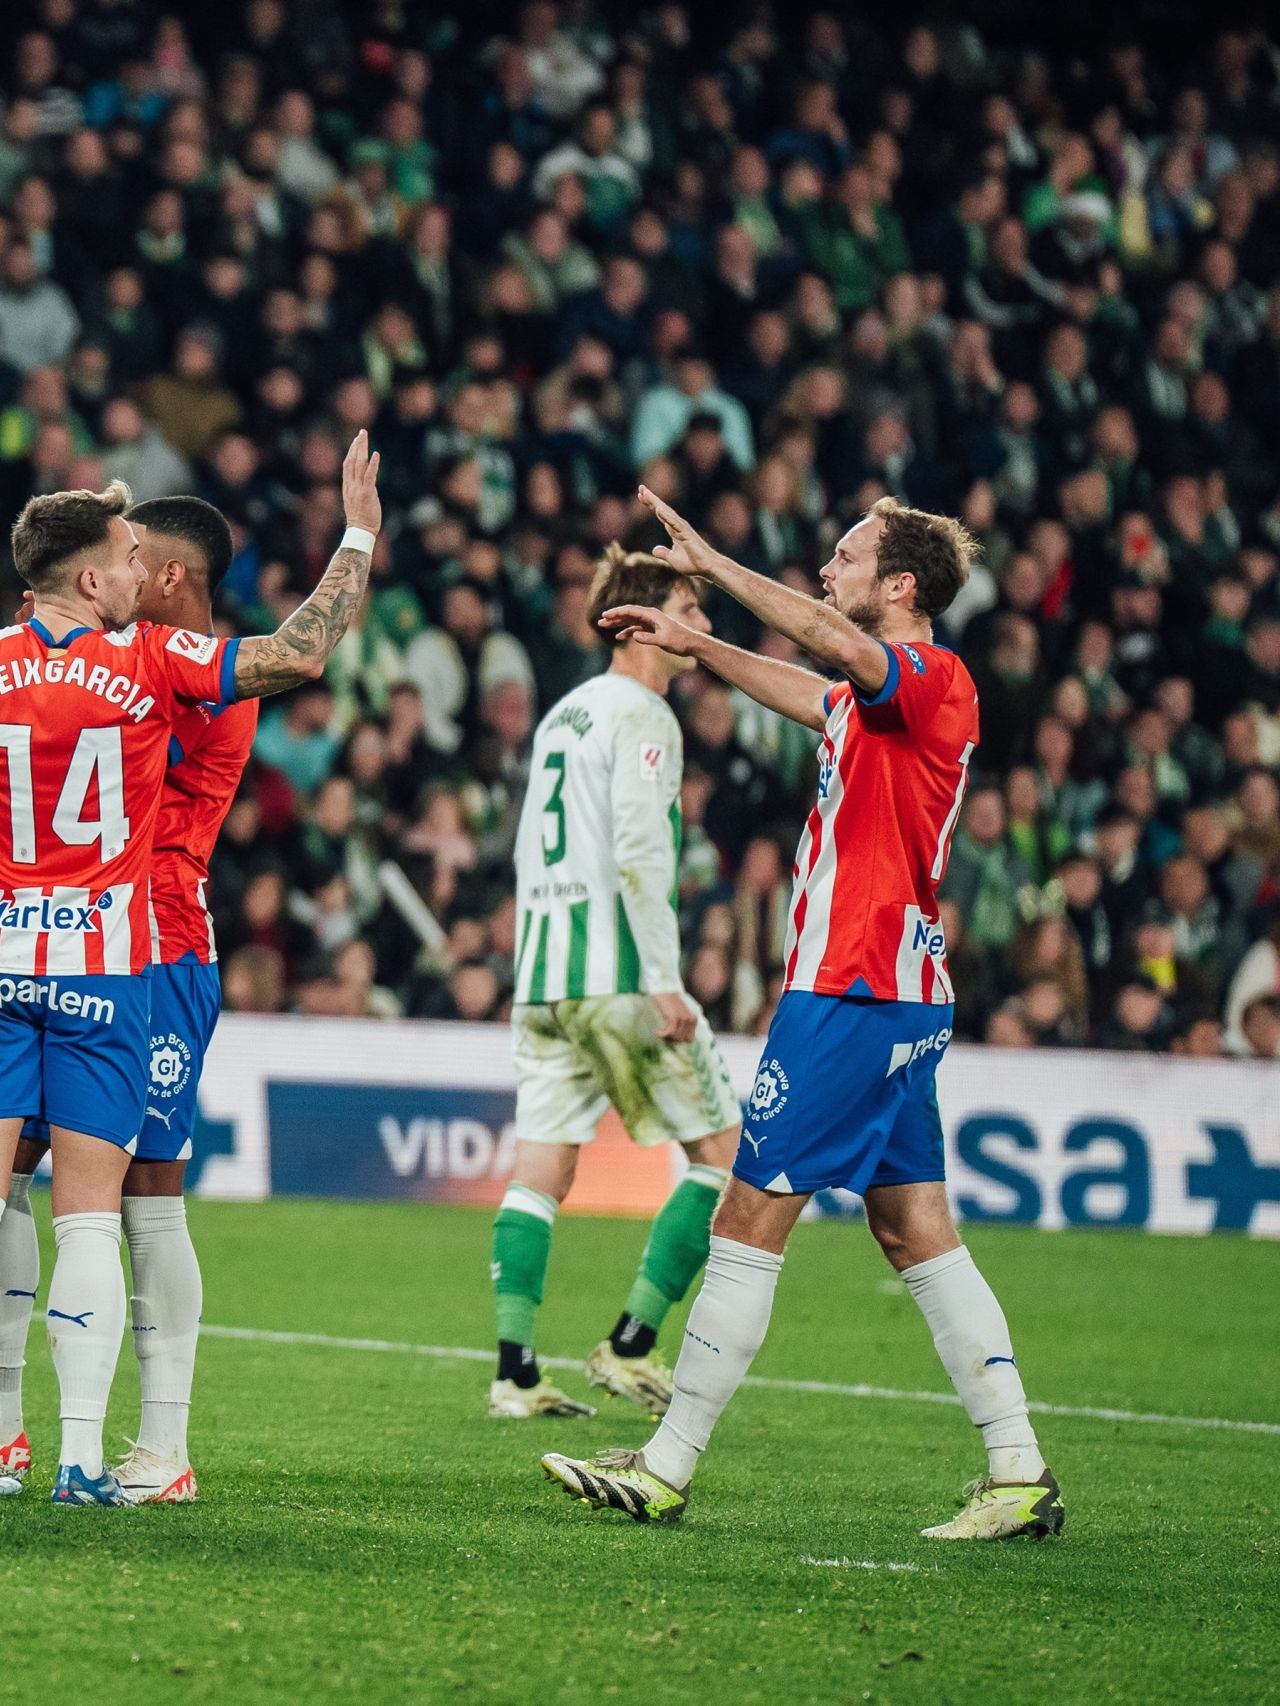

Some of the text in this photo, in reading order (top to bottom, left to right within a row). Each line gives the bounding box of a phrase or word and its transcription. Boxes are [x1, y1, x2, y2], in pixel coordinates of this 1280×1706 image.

[542, 751, 567, 867] 3
[168, 1032, 191, 1062] Brava
[160, 1089, 172, 1098] de
[172, 1066, 191, 1095] Girona
[769, 1058, 790, 1091] Brava
[762, 1095, 788, 1121] Girona
